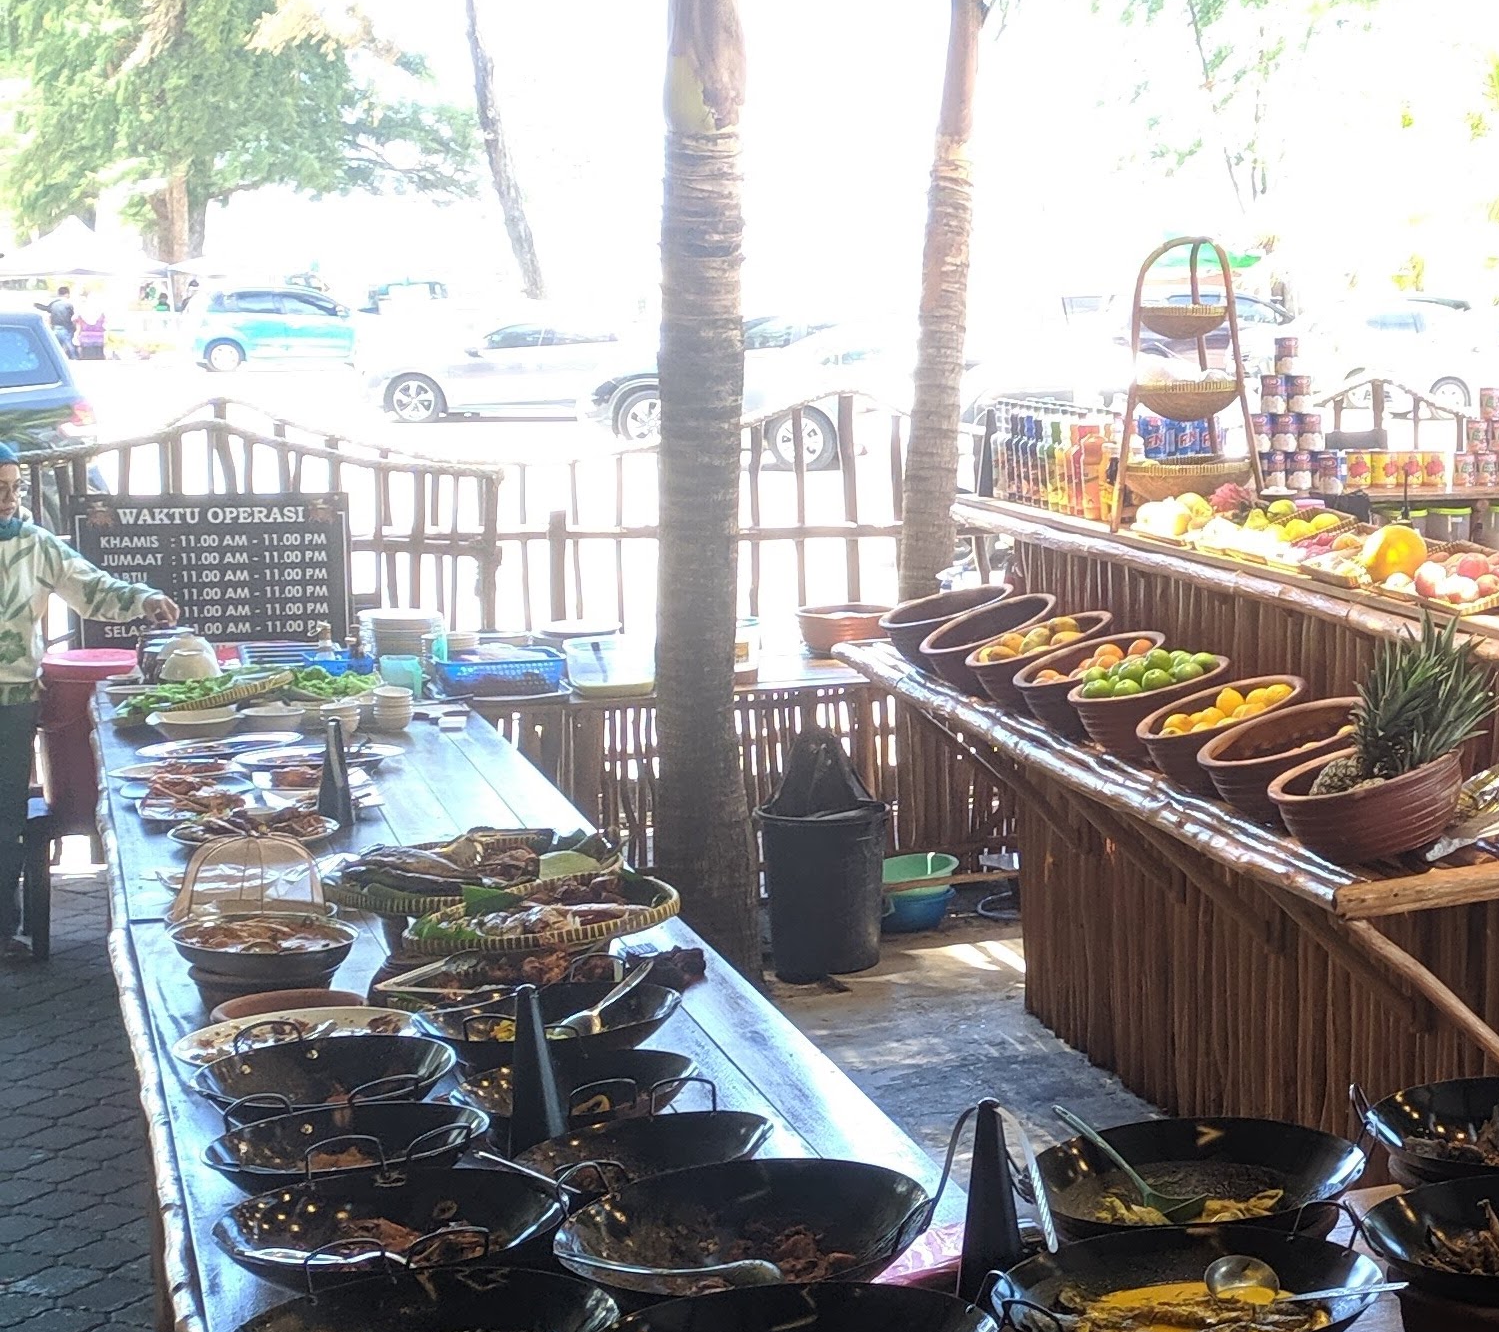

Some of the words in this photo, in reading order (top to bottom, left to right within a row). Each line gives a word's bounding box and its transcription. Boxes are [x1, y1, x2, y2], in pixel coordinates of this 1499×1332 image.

[116, 507, 200, 525] WAKTU
[206, 506, 306, 524] OPERASI
[100, 535, 160, 548] KHAMIS
[180, 534, 219, 547] 11.00
[222, 534, 248, 546] AM
[263, 533, 301, 546] 11.00
[304, 532, 327, 545] PM
[101, 553, 164, 566] JUMAAT
[181, 552, 220, 565] 11.00
[223, 552, 249, 564] AM
[263, 550, 302, 563] 11.00
[305, 550, 328, 562] PM
[181, 570, 221, 583] 11.00
[223, 569, 250, 581] AM
[264, 568, 302, 581] 11.00
[305, 568, 328, 579] PM
[182, 587, 221, 600] 11.00
[224, 586, 251, 599] AM
[264, 585, 302, 598] 11.00
[306, 585, 329, 597] PM
[183, 605, 222, 617] 11.00
[225, 604, 251, 616] AM
[265, 603, 303, 615] 11.00
[306, 602, 329, 614] PM
[226, 622, 252, 634] AM
[265, 620, 304, 633] 11.00
